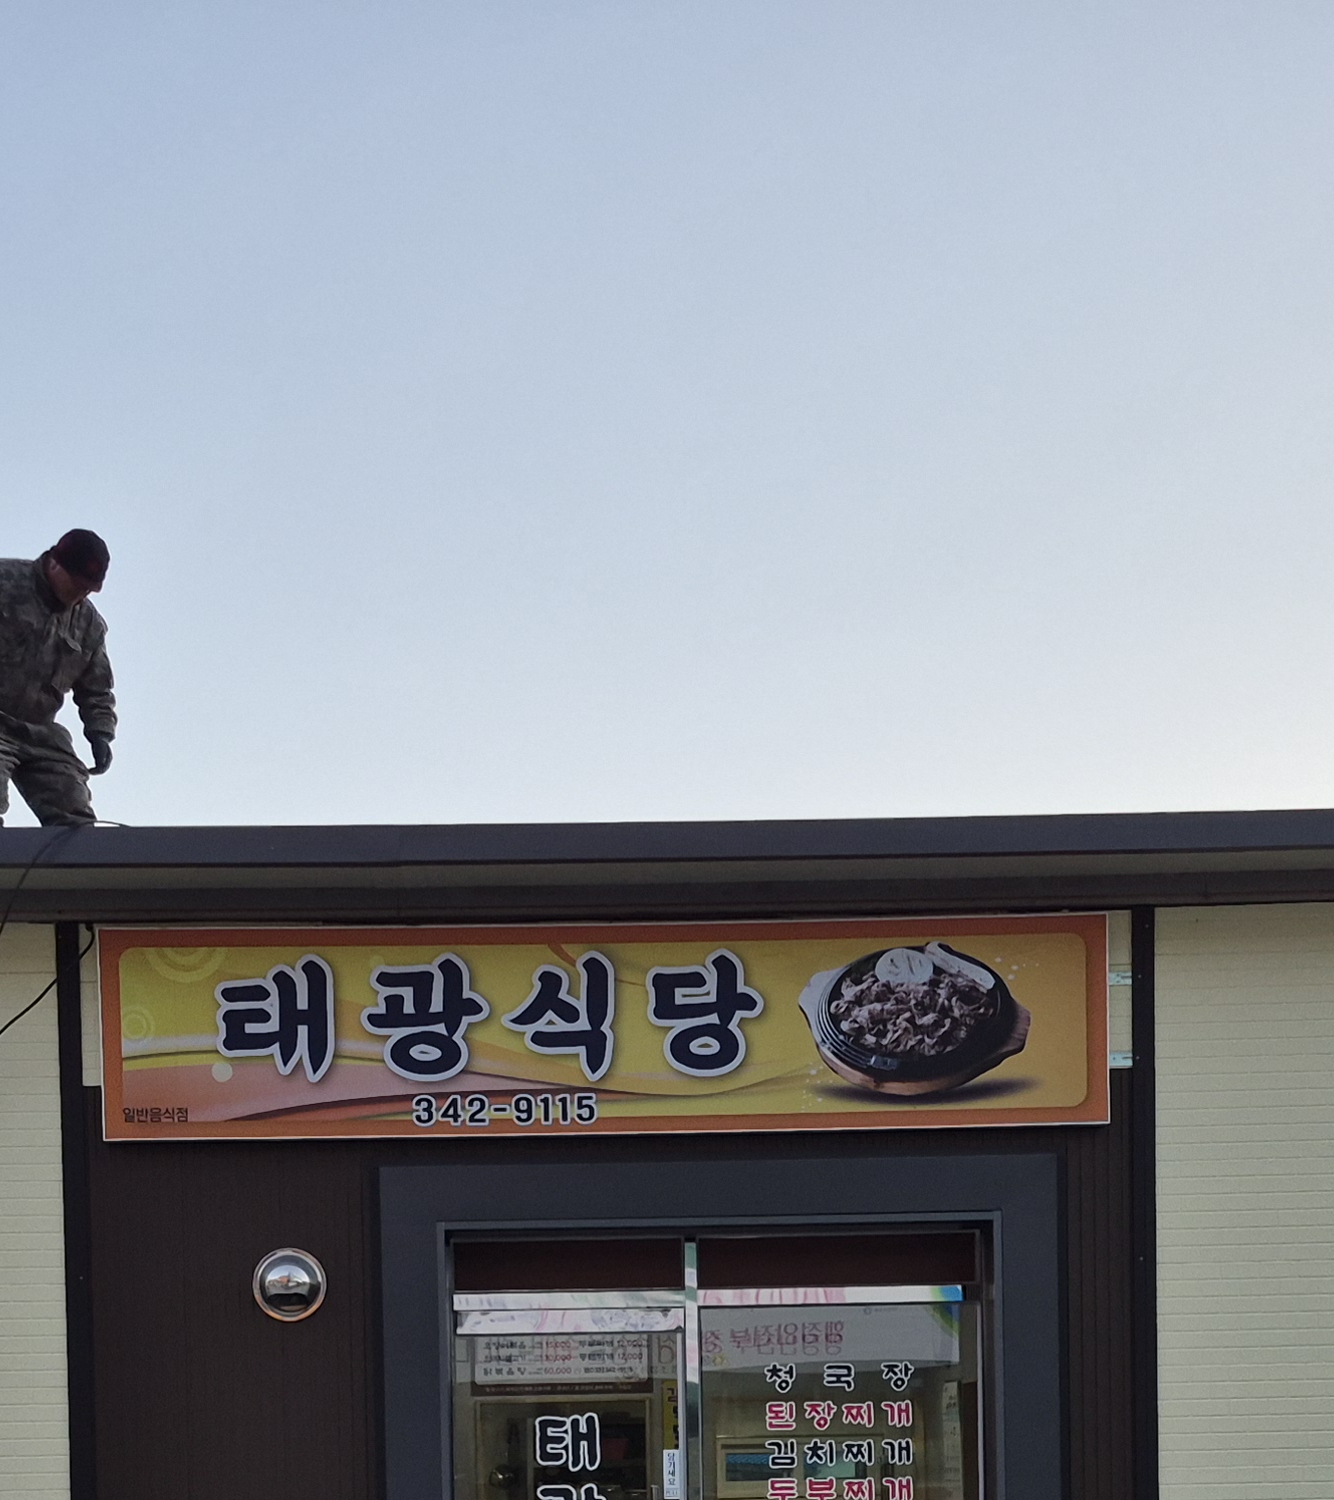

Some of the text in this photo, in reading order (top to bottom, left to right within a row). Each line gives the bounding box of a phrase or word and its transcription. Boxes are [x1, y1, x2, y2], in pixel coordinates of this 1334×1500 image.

[214, 949, 764, 1084] 태광식당
[122, 1106, 189, 1123] 일반음식점
[410, 1092, 598, 1127] 342-9115
[764, 1361, 915, 1393] 청국장
[766, 1400, 913, 1431] 된장찌개
[765, 1438, 914, 1470] 김치찌개
